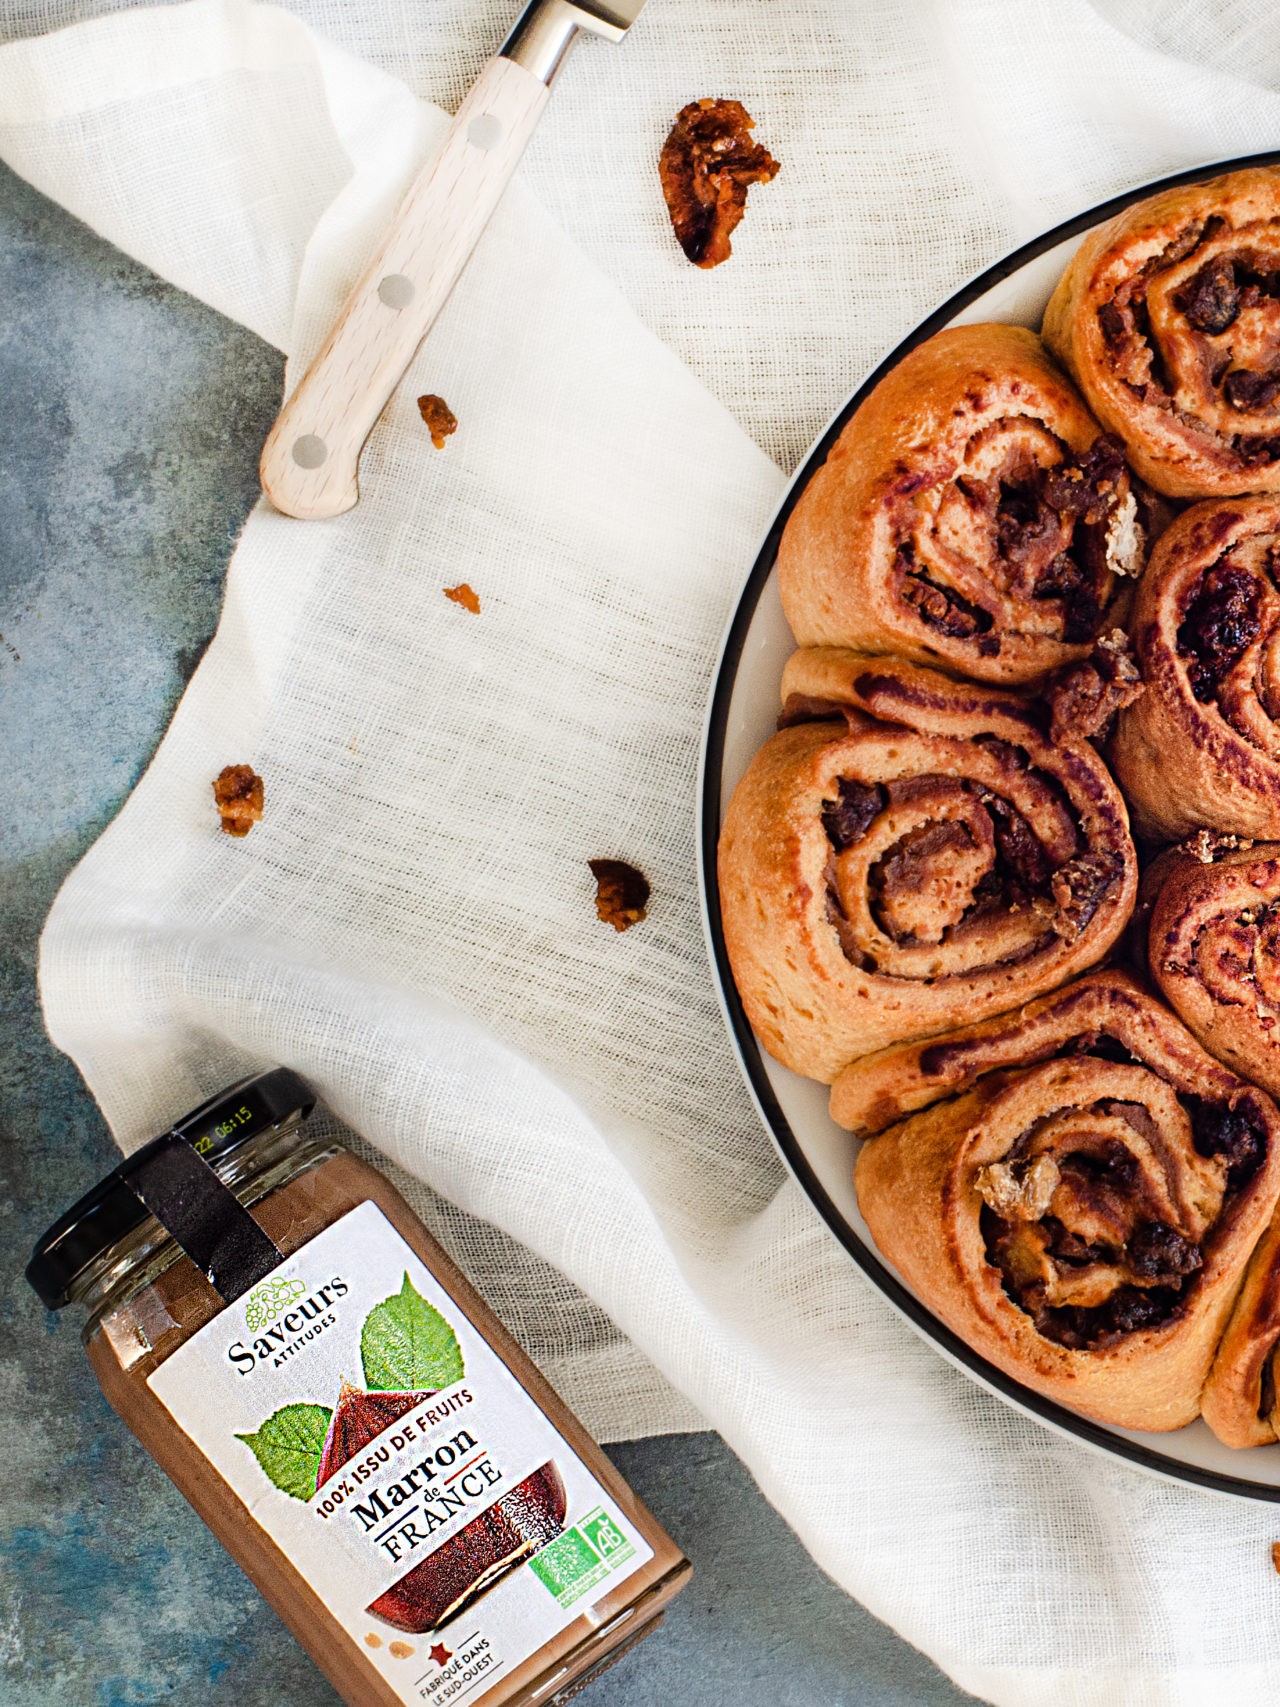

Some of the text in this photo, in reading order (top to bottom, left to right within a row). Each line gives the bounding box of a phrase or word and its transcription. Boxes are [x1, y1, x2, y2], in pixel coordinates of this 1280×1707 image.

[214, 1106, 253, 1139] 06:15
[228, 1276, 349, 1376] Saveurs
[273, 1313, 337, 1368] ATTITUDES
[316, 1388, 474, 1519] 100% ISSU DE FRUITS
[349, 1429, 479, 1532] Marron
[380, 1459, 503, 1563] FRANCE
[423, 1486, 441, 1503] de
[597, 1526, 622, 1556] AB
[461, 1638, 490, 1664] DANS
[432, 1653, 494, 1706] LE SUD-OUEST
